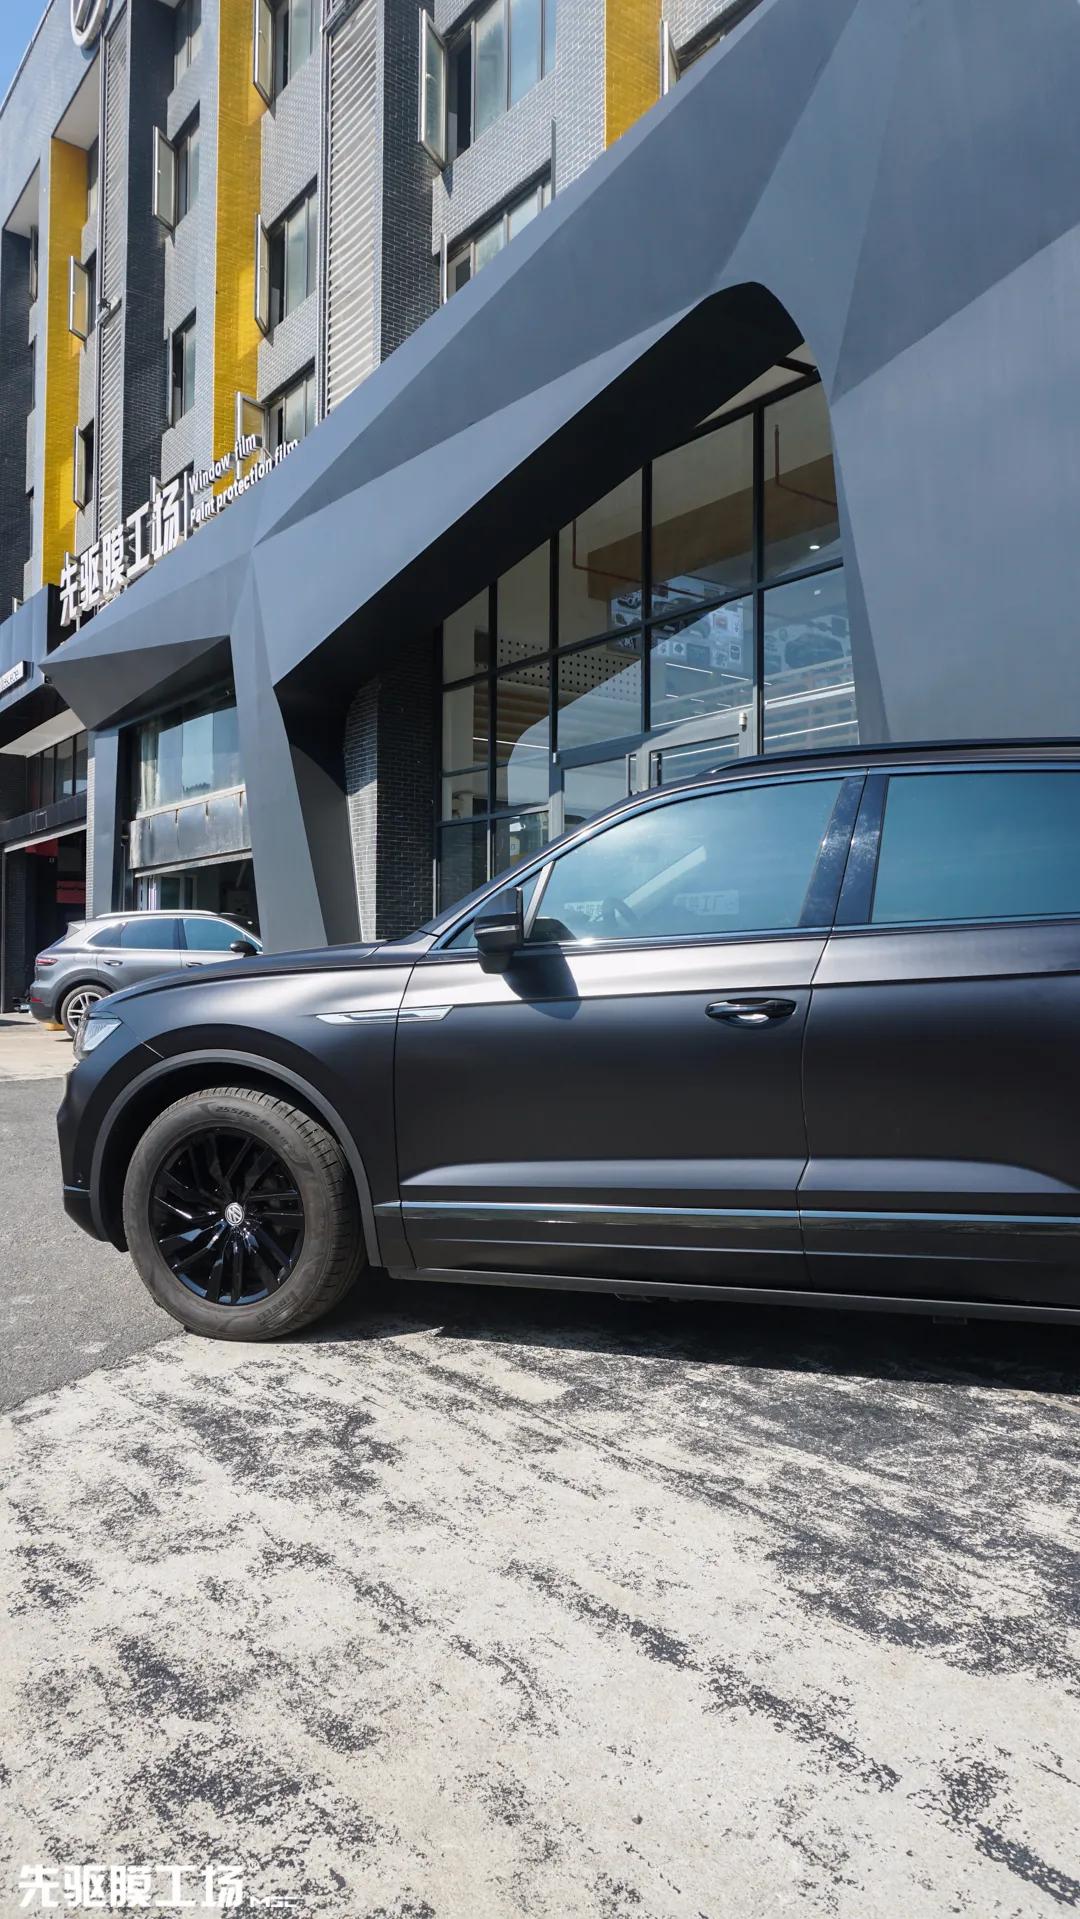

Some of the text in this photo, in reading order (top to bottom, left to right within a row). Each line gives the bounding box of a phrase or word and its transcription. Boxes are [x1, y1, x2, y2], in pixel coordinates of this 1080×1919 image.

[189, 434, 256, 494] Window film
[190, 439, 298, 527] Paint protection film
[59, 478, 180, 627] 先驱膜工场
